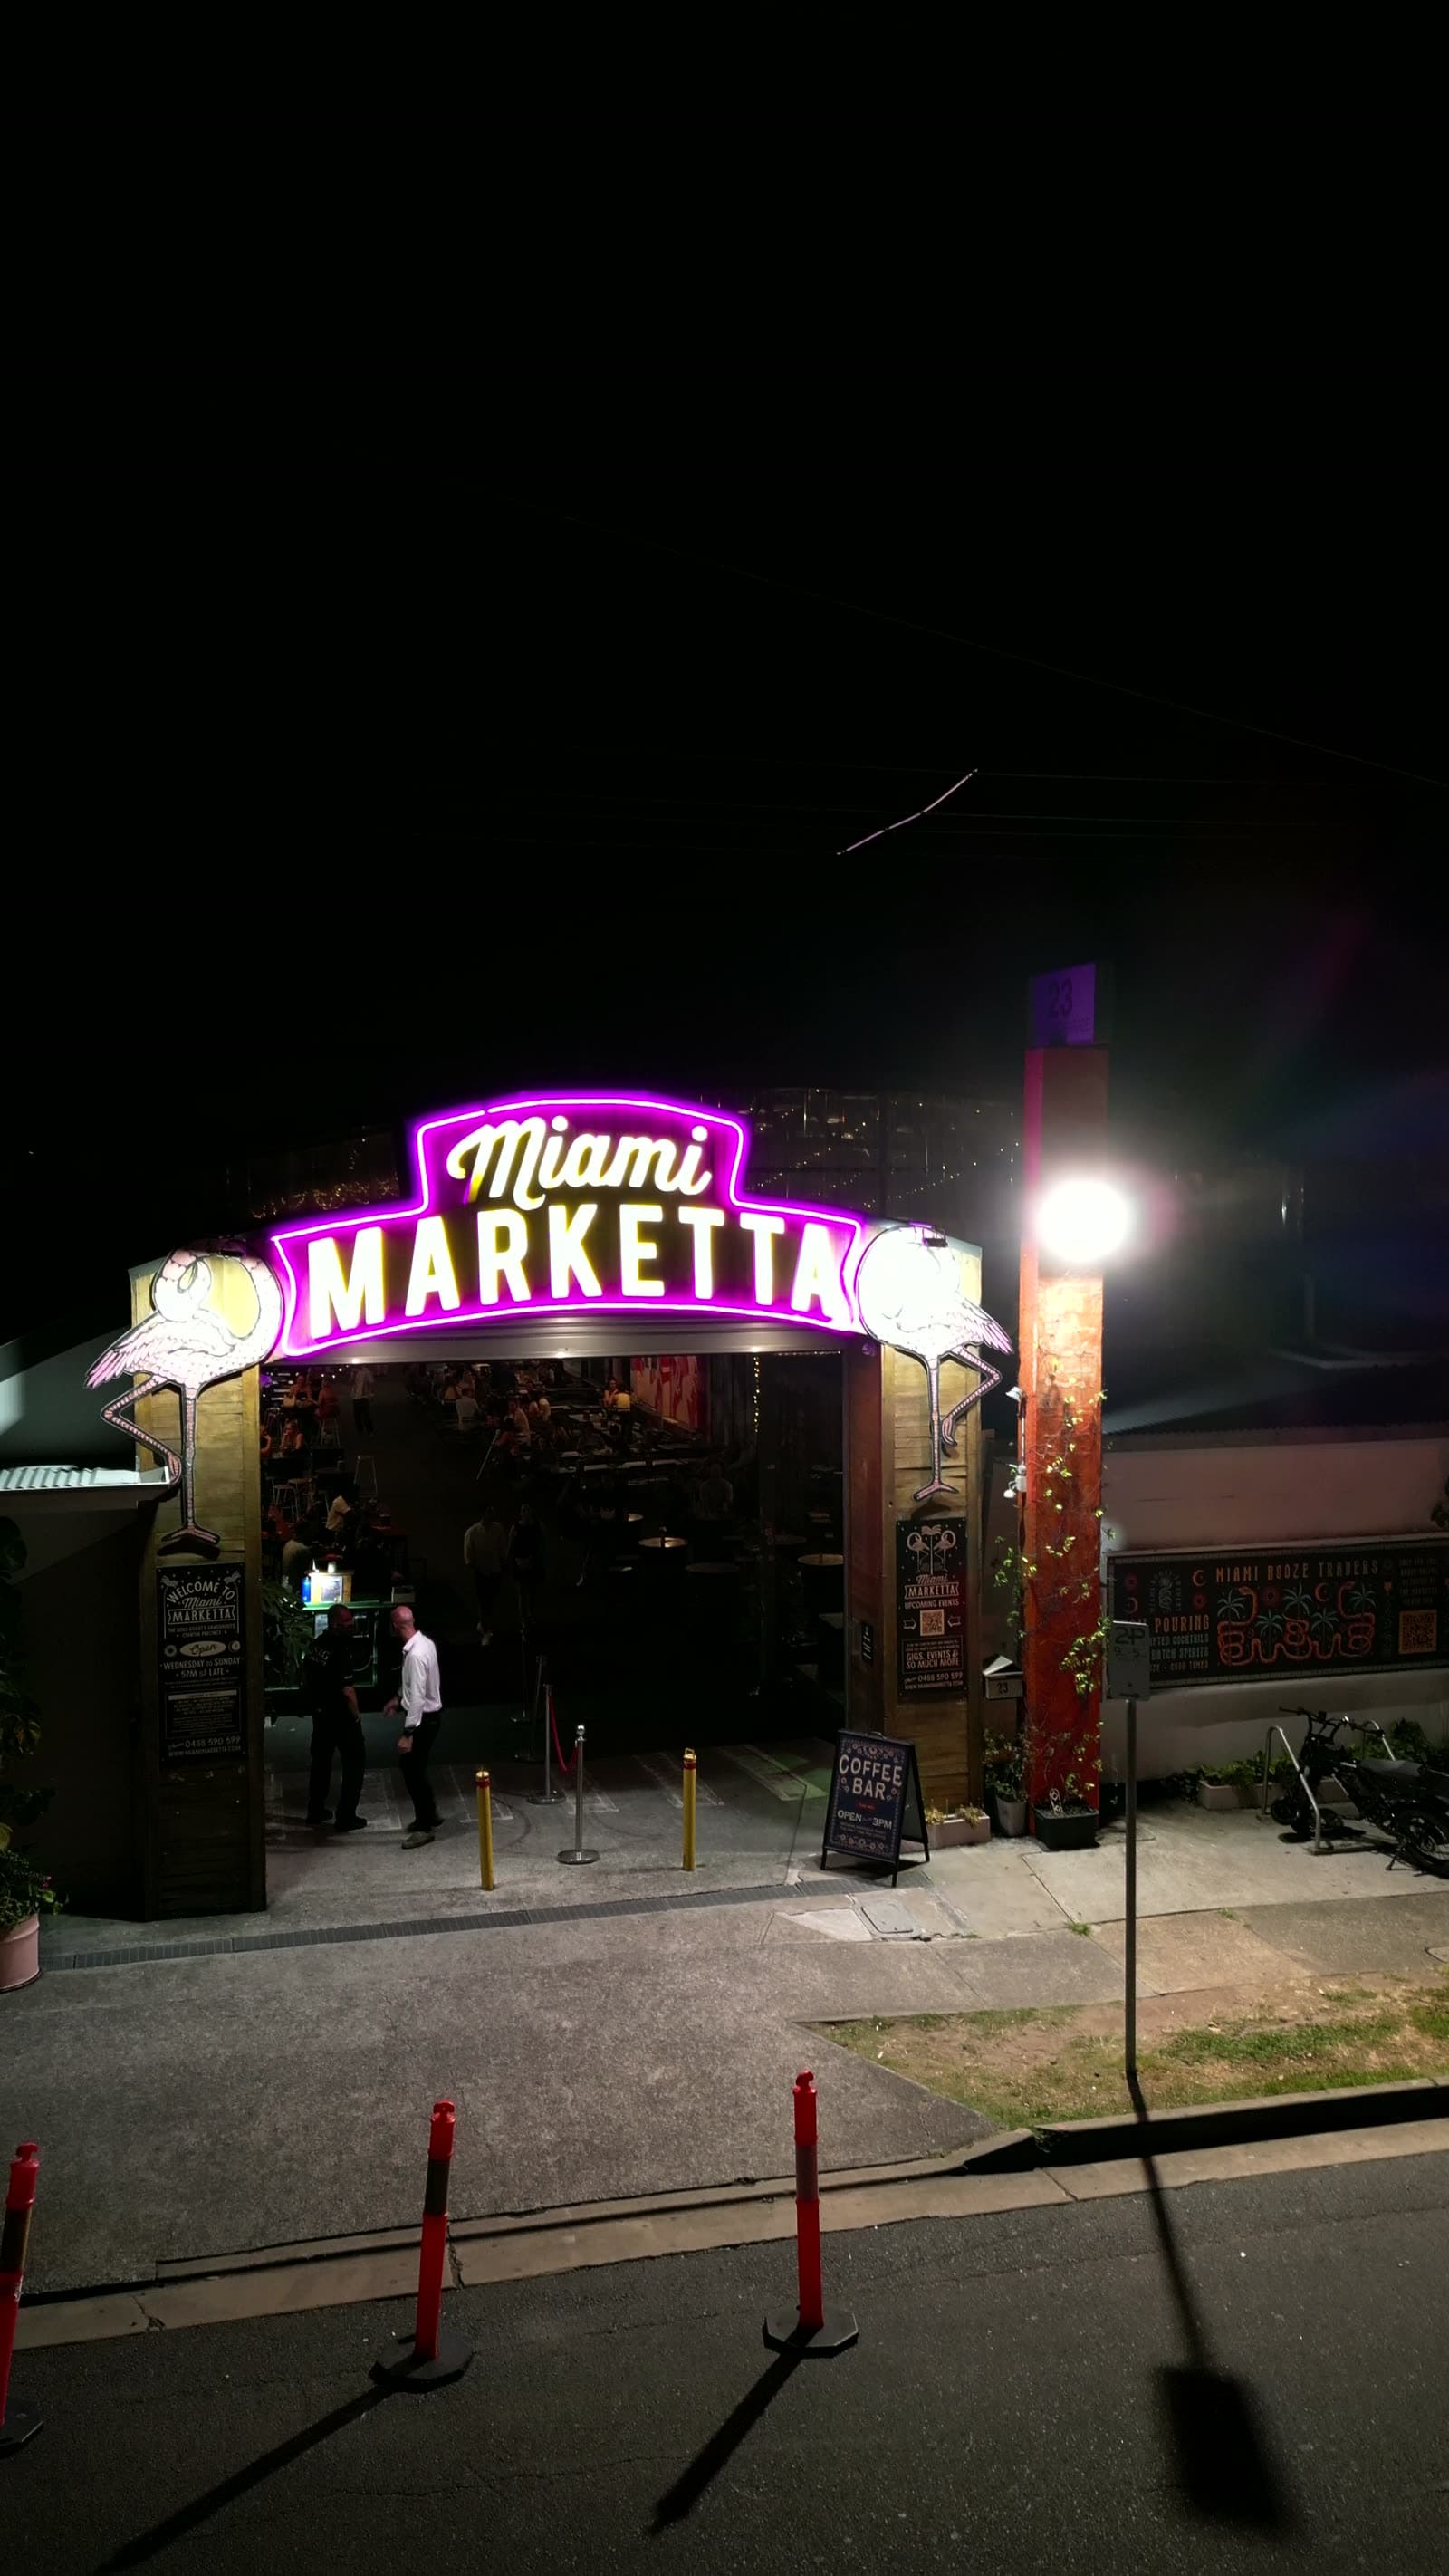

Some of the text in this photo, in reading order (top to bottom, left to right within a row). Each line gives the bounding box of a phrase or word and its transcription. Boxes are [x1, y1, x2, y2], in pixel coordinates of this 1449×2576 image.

[1050, 978, 1073, 1018] 23
[446, 1116, 712, 1211] Miami
[307, 1203, 847, 1339] MARKETTA
[1216, 1559, 1377, 1582] MIAMI BOOZE TRADERS
[916, 1573, 948, 1587] Miami
[167, 1581, 235, 1603] WELCOME TO
[908, 1585, 955, 1598] MARKETTA
[182, 1596, 223, 1610] Miami
[905, 1598, 960, 1610] UPCOMING EVENTS
[173, 1609, 231, 1622] MARKETTA
[1155, 1614, 1210, 1633] POURING
[1115, 1628, 1145, 1645] 2P
[1151, 1636, 1171, 1647] FTED
[188, 1644, 217, 1657] Open
[926, 1649, 951, 1659] EVENTS
[163, 1659, 205, 1670] WEDNESDAY
[214, 1657, 241, 1667] SUNDAY
[906, 1658, 959, 1669] SO MUCH MORE
[181, 1669, 197, 1679] 5PM
[208, 1668, 224, 1677] LATE
[839, 1754, 903, 1787] COFFEE
[852, 1777, 886, 1801] BAR
[837, 1810, 862, 1822] OPEN
[871, 1817, 892, 1830] 3PM
